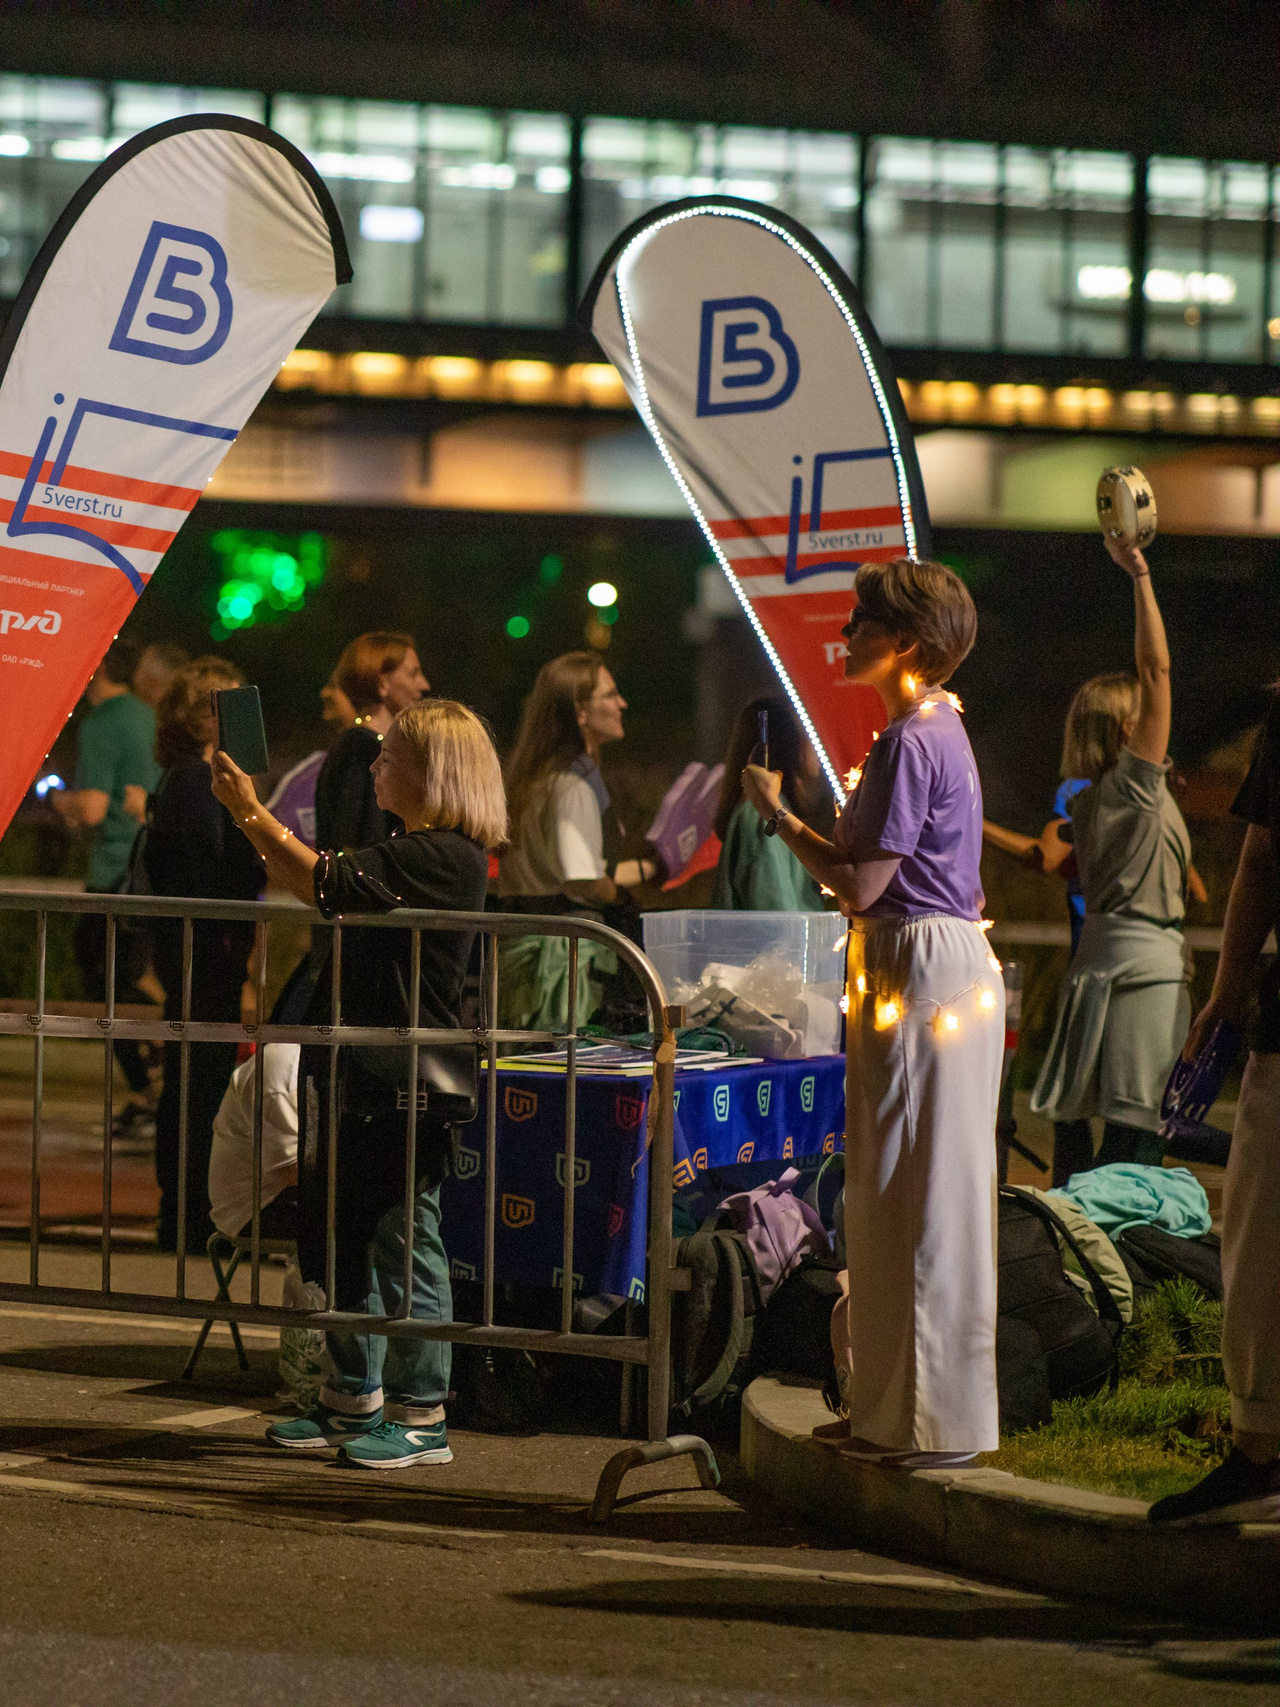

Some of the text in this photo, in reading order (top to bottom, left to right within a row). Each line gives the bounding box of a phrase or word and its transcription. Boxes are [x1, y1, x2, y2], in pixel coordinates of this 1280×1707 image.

[42, 486, 123, 518] 5verst.ru
[809, 531, 883, 550] 5verst.ru
[51, 583, 85, 596] ПАРТНЕР
[1, 653, 17, 664] ОАО
